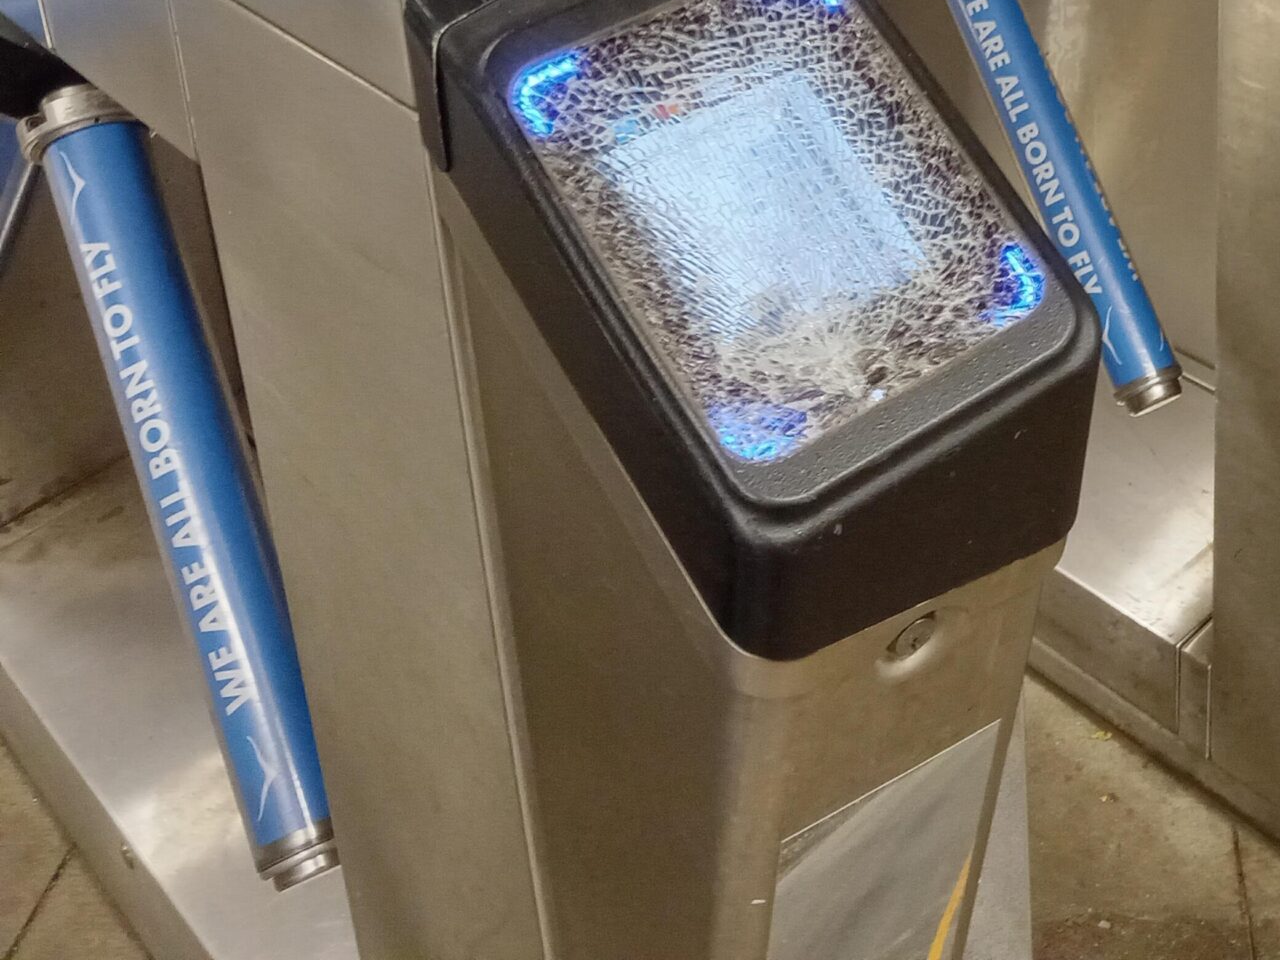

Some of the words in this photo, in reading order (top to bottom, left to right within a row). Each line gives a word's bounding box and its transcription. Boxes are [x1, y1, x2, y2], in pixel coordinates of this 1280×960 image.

[973, 20, 1011, 72] ARE
[995, 75, 1029, 124] ALL
[1016, 122, 1065, 207] BORN
[1052, 206, 1081, 248] TO
[1067, 250, 1103, 294] FLY
[79, 242, 122, 300] FLY
[103, 304, 141, 361] TO
[120, 360, 182, 480] BORN
[159, 478, 208, 549] ALL
[181, 552, 235, 633] ARE
[208, 644, 254, 717] WE
